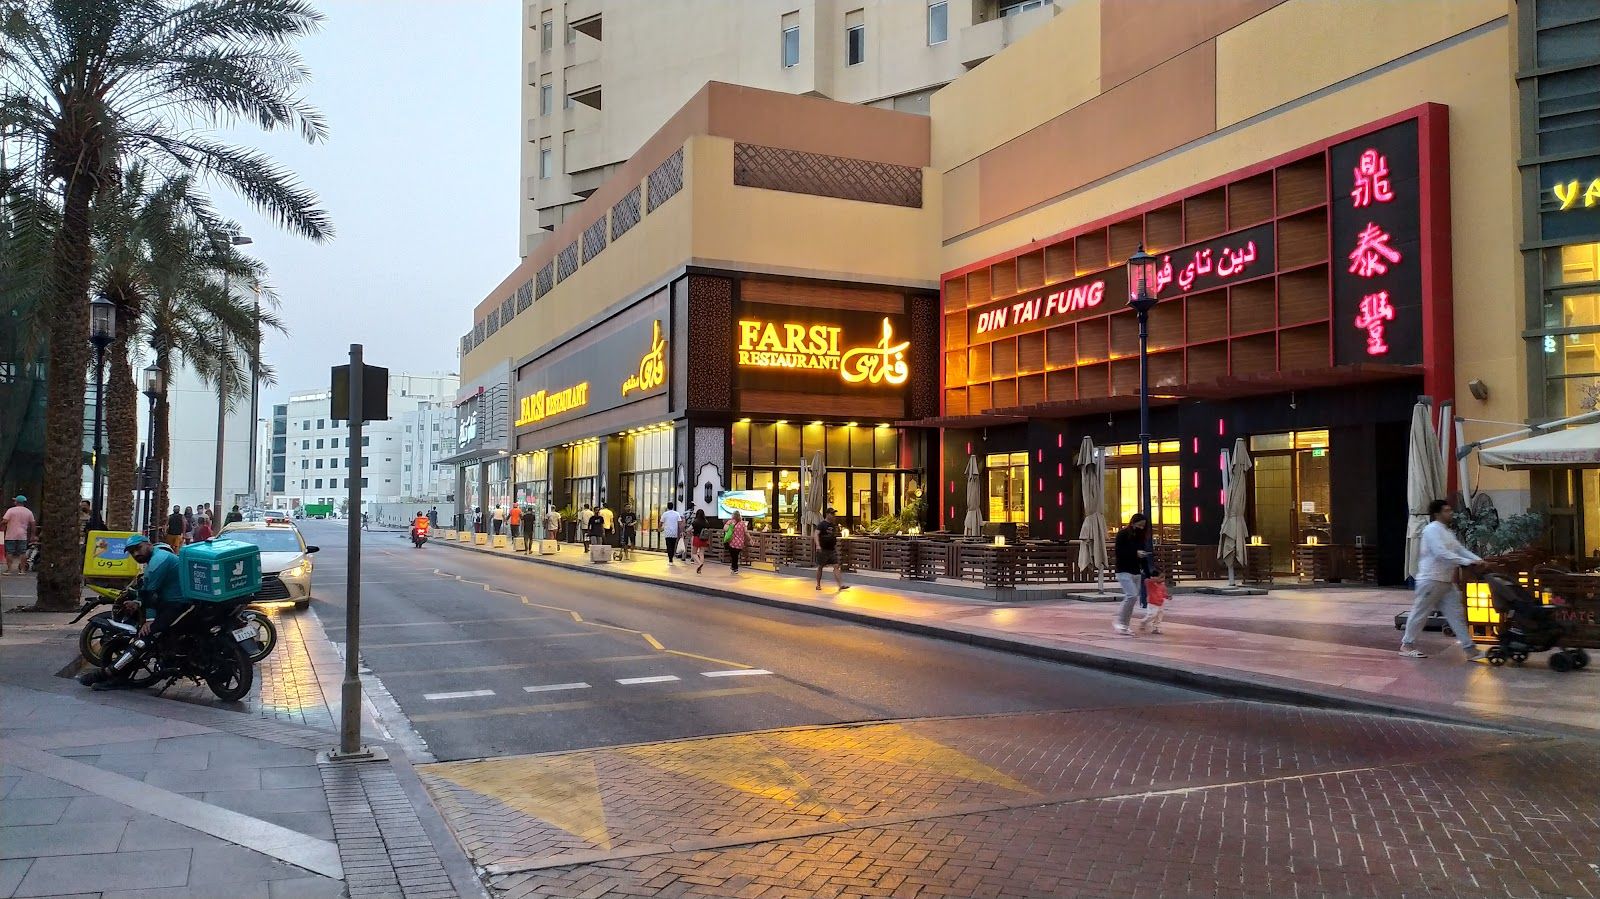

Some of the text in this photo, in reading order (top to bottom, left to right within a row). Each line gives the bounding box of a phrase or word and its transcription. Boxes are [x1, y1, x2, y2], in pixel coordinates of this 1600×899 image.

[1179, 248, 1213, 291] تاي
[1217, 241, 1257, 277] دين
[977, 281, 1104, 333] DIN TAI FUNG
[739, 321, 841, 355] FARSI
[739, 350, 840, 369] RESTAURANT
[516, 382, 588, 425] FARSI RESTAURANT
